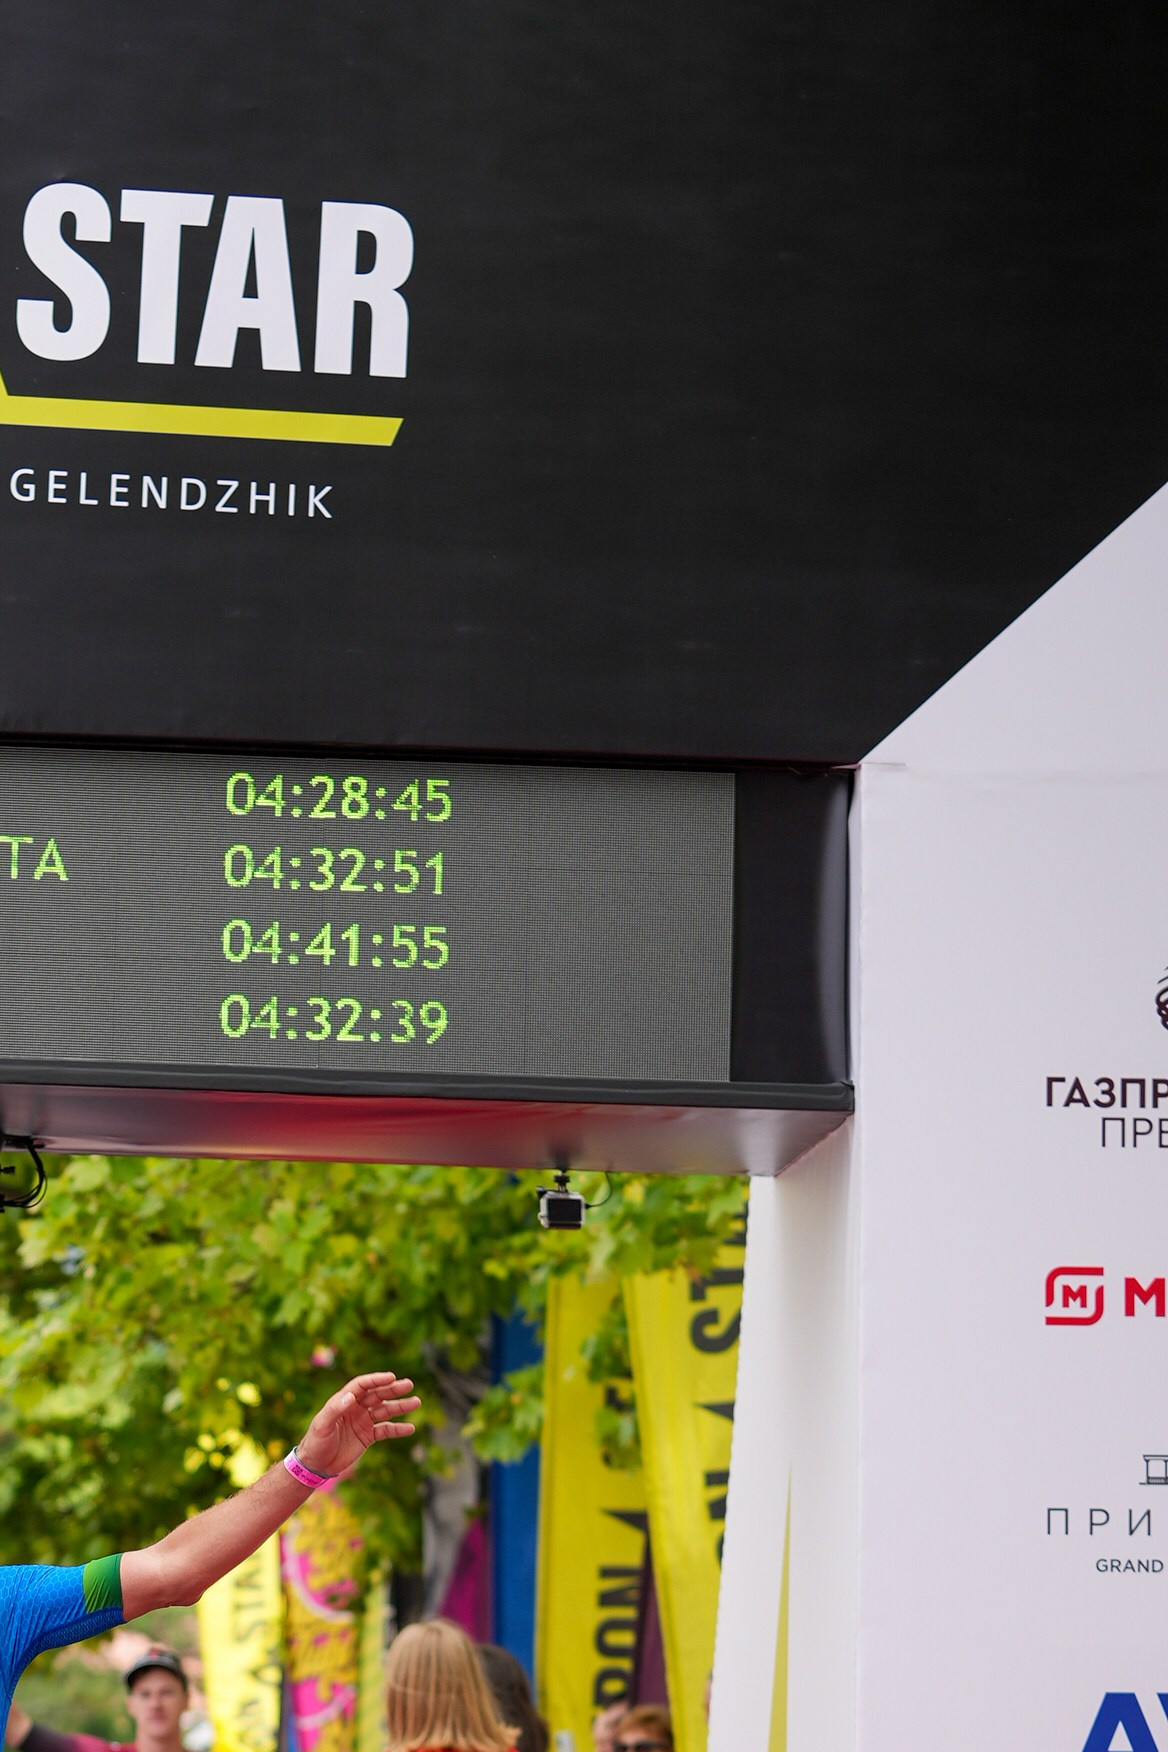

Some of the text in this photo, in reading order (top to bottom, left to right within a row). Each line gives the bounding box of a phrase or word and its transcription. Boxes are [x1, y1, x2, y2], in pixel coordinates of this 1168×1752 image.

[16, 182, 414, 378] STAR
[10, 468, 334, 519] GELENDZHIK
[225, 772, 453, 822] 04:28:45
[223, 843, 445, 895] 04:32:51
[221, 917, 450, 969] 04:41:55
[218, 992, 449, 1044] 04:32:39
[1047, 1507, 1151, 1537] ПРИ
[1095, 1558, 1164, 1573] GRAND
